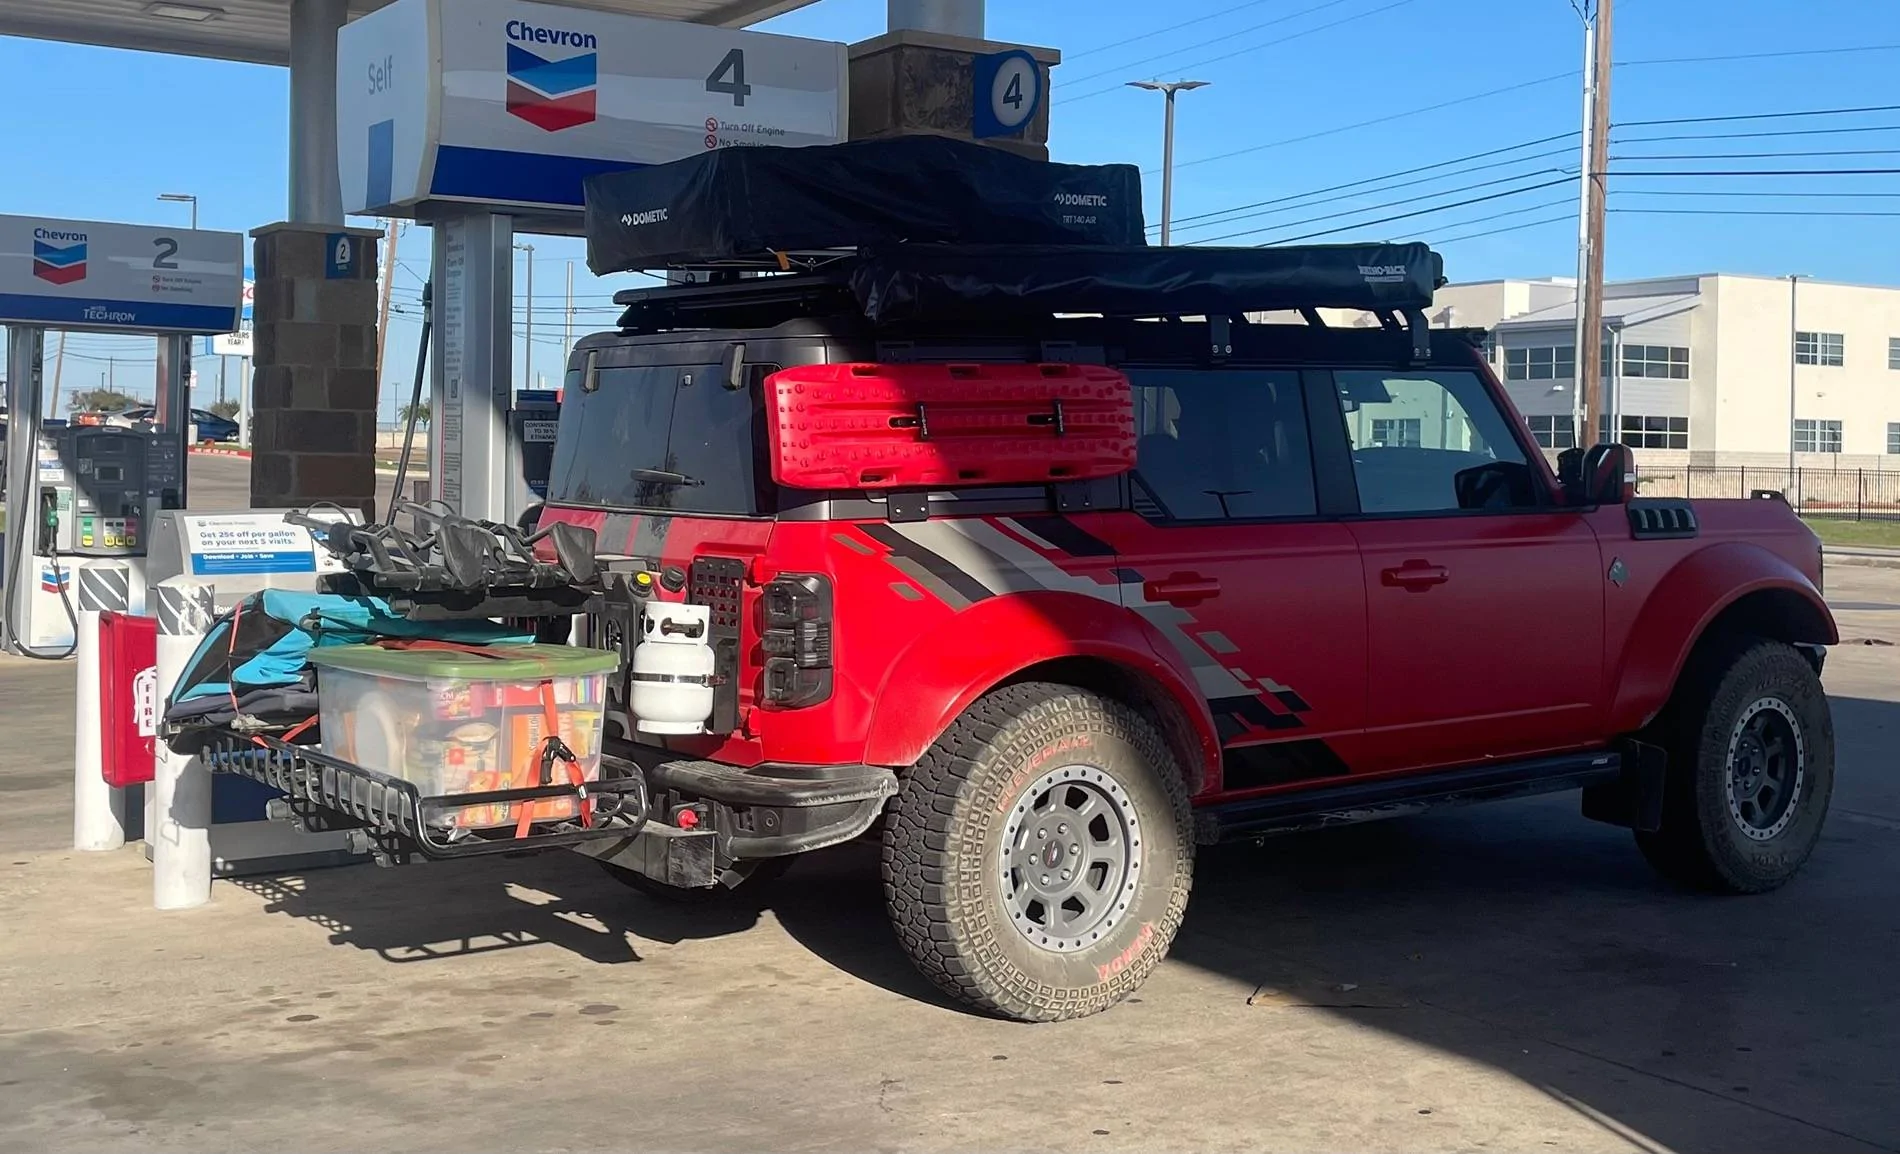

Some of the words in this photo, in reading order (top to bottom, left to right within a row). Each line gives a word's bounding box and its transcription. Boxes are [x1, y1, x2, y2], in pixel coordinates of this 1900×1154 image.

[506, 20, 597, 49] Chevron
[368, 55, 393, 95] Self
[706, 48, 751, 107] 4
[1003, 72, 1022, 109] 4
[720, 121, 739, 131] Turn
[741, 123, 754, 133] Off
[757, 126, 785, 136] Engine
[719, 138, 731, 147] No
[734, 139, 769, 148] Smokin
[1065, 194, 1107, 206] DOMETIC
[633, 208, 668, 225] DOMETIC
[34, 228, 88, 242] Chevron
[153, 237, 178, 269] 2
[340, 243, 346, 260] 2
[84, 308, 136, 322] TECHRON
[251, 531, 265, 539] per
[268, 530, 296, 538] gallon
[144, 684, 152, 727] FIRE
